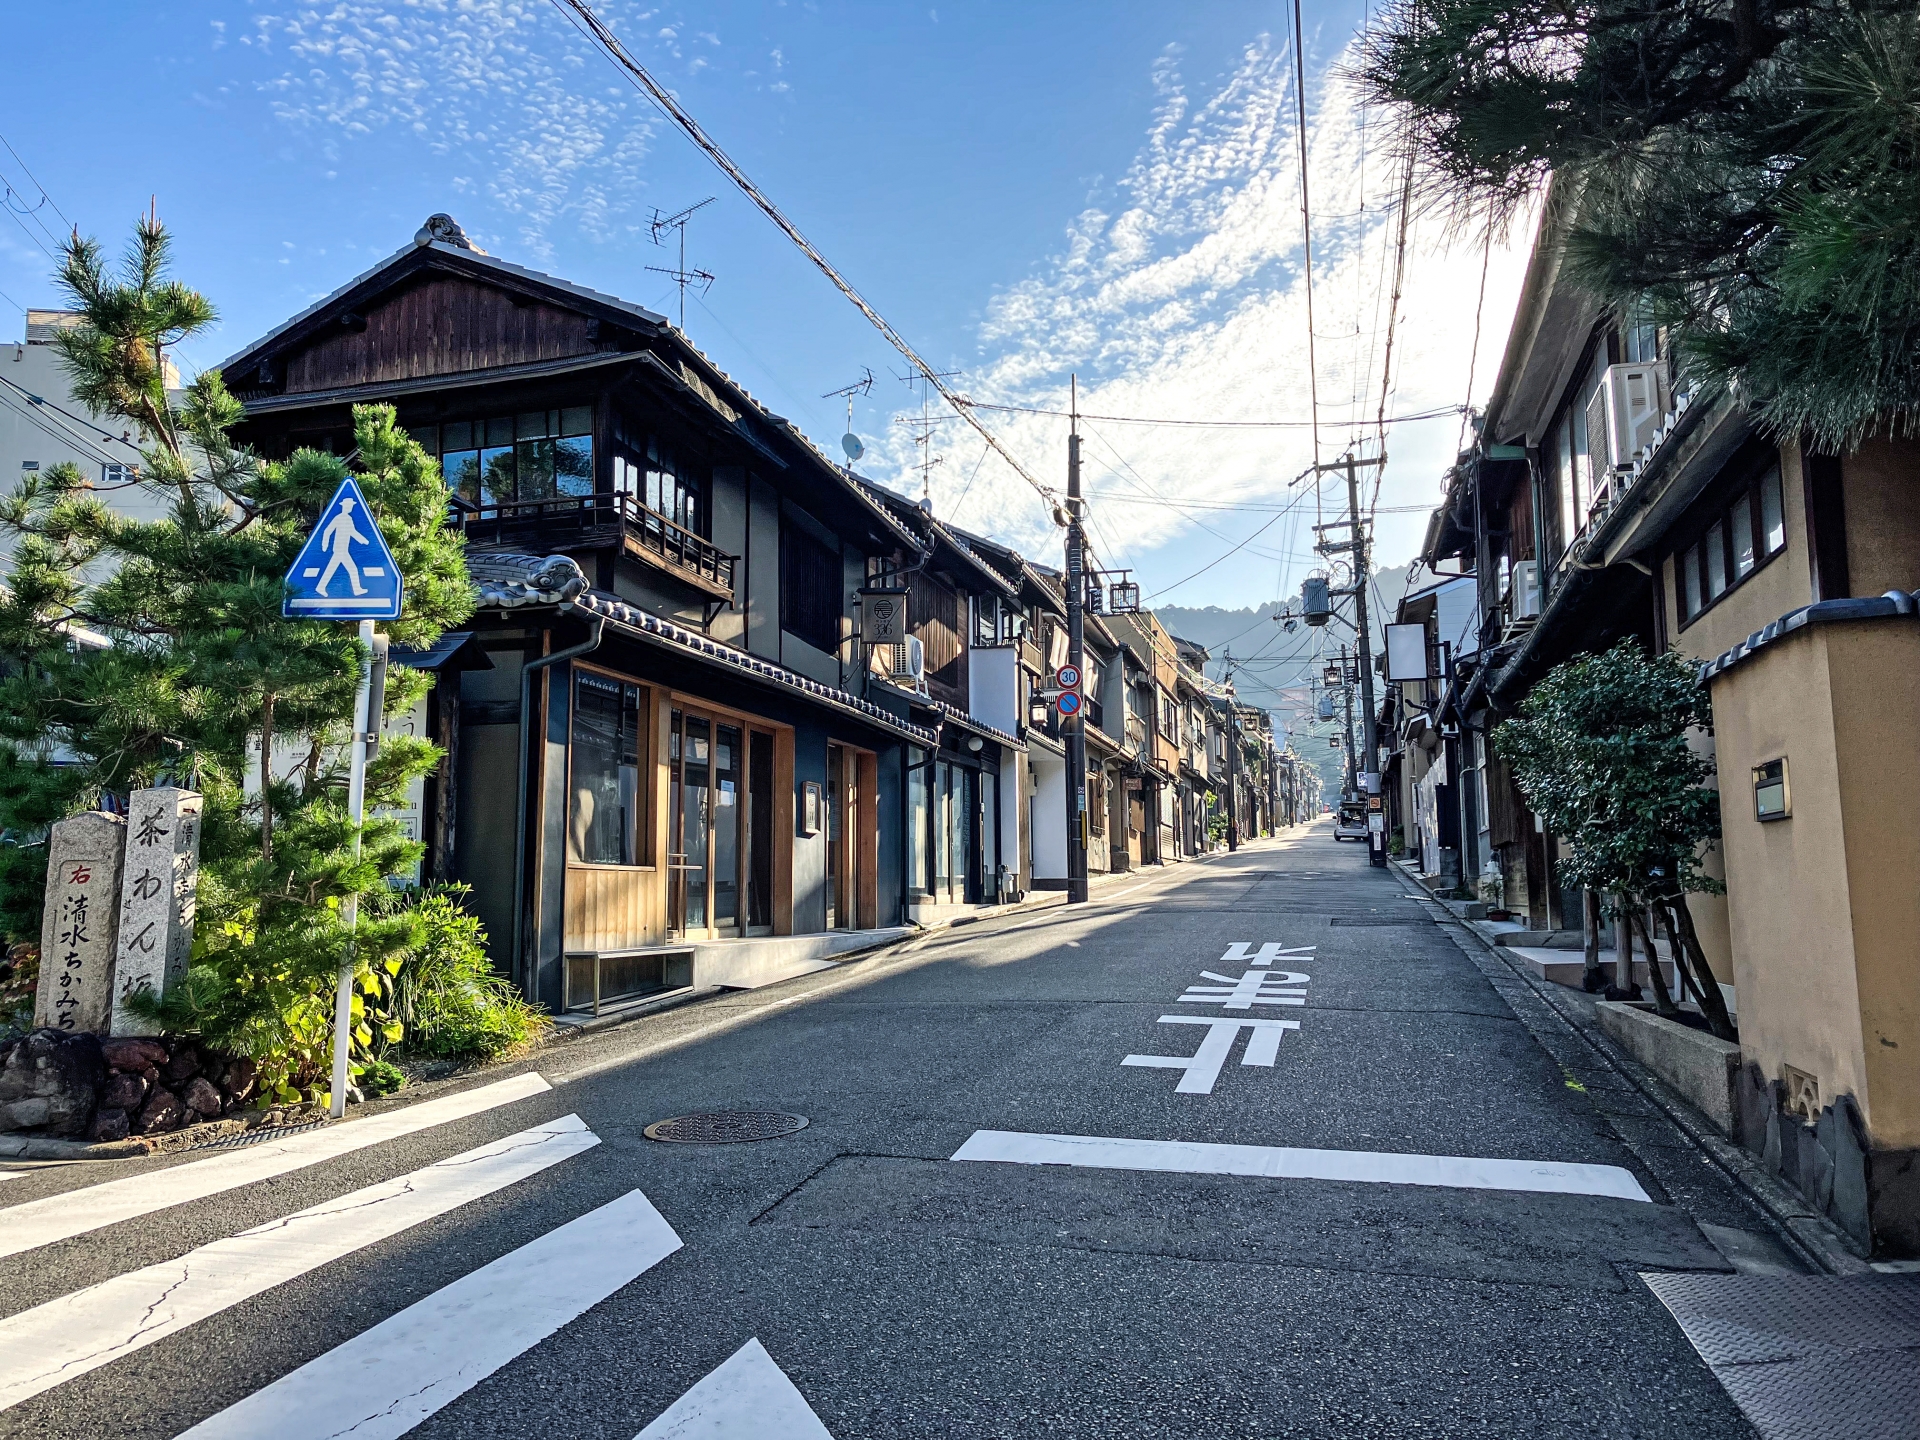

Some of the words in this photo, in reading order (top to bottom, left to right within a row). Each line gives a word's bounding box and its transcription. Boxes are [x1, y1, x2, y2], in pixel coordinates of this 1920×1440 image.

[874, 623, 893, 636] 336
[1061, 671, 1076, 683] 30
[68, 864, 92, 885] 右
[56, 893, 91, 1031] 清水ちかみち
[1119, 941, 1317, 1095] 止まれ
